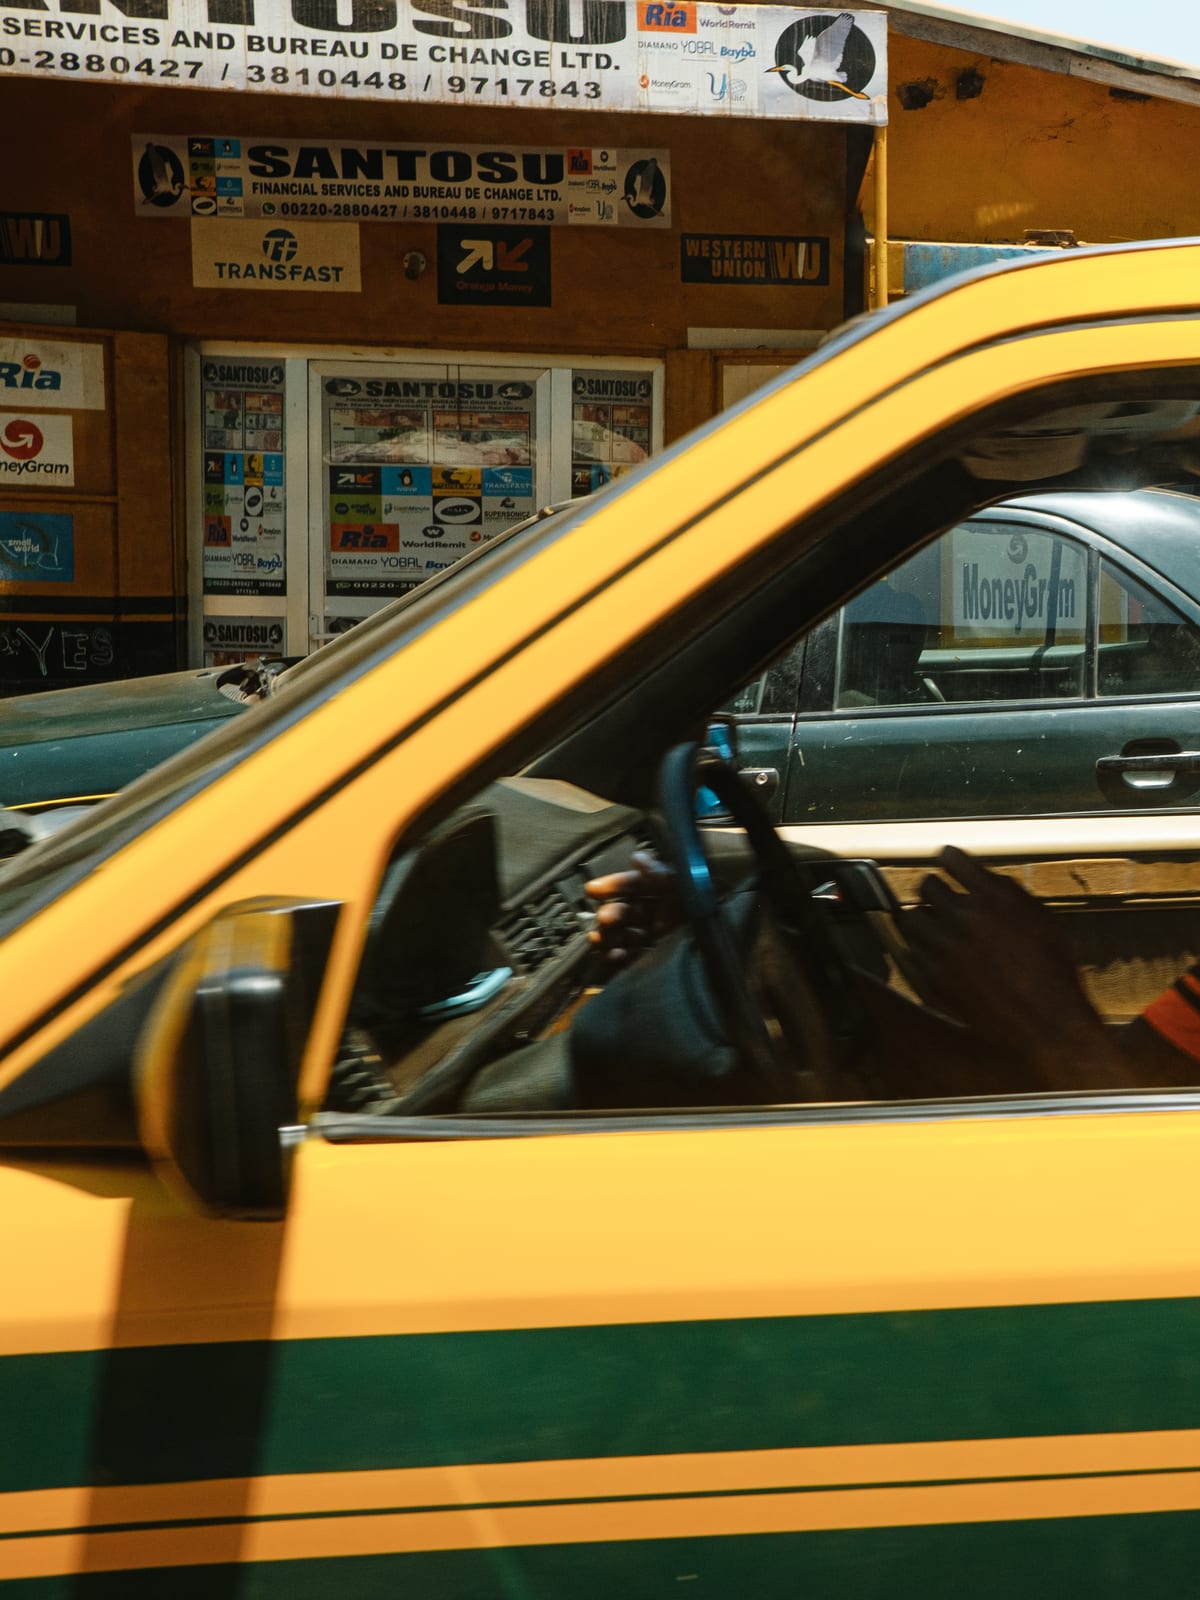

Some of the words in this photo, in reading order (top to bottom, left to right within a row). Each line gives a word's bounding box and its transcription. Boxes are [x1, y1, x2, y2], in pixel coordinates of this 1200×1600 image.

[646, 1, 687, 27] Ria
[700, 19, 756, 30] WorldRemit
[2, 17, 161, 46] SERVICES
[171, 30, 236, 50] AND
[247, 35, 369, 59] BUREAU
[380, 42, 418, 61] DE
[429, 45, 550, 67] CHANGE
[561, 51, 620, 71] LTD.
[638, 41, 678, 50] DIAMANO
[221, 63, 230, 81] /
[246, 64, 407, 90] 3810448
[423, 74, 431, 91] /
[447, 75, 603, 99] 9717843
[651, 80, 692, 89] MoneyGram
[248, 145, 564, 184] SANTOSU
[253, 182, 318, 196] FINANCIAL
[321, 184, 380, 197] SERVICES
[384, 186, 409, 197] AND
[413, 186, 461, 199] BUREAU
[465, 188, 481, 199] DE
[484, 188, 533, 201] CHANGE
[537, 190, 562, 201] LTD.
[281, 202, 397, 217] 00220-2880427
[413, 205, 477, 219] 3810448
[492, 207, 555, 221] 9717843
[686, 239, 766, 259] WESTERN
[774, 241, 821, 280] WU
[711, 259, 766, 279] UNION
[214, 262, 344, 282] TRANSFAST
[0, 354, 62, 391] Ria
[219, 365, 269, 383] SANTOSU
[366, 381, 493, 399] SANTOSU
[588, 379, 637, 396] SANTOSU
[340, 524, 388, 549] Ria
[402, 540, 466, 549] WorldRemit
[15, 544, 40, 553] world
[963, 562, 1075, 635] MoneyGrm
[218, 624, 268, 643] SANTOSU
[17, 626, 114, 677] YES
